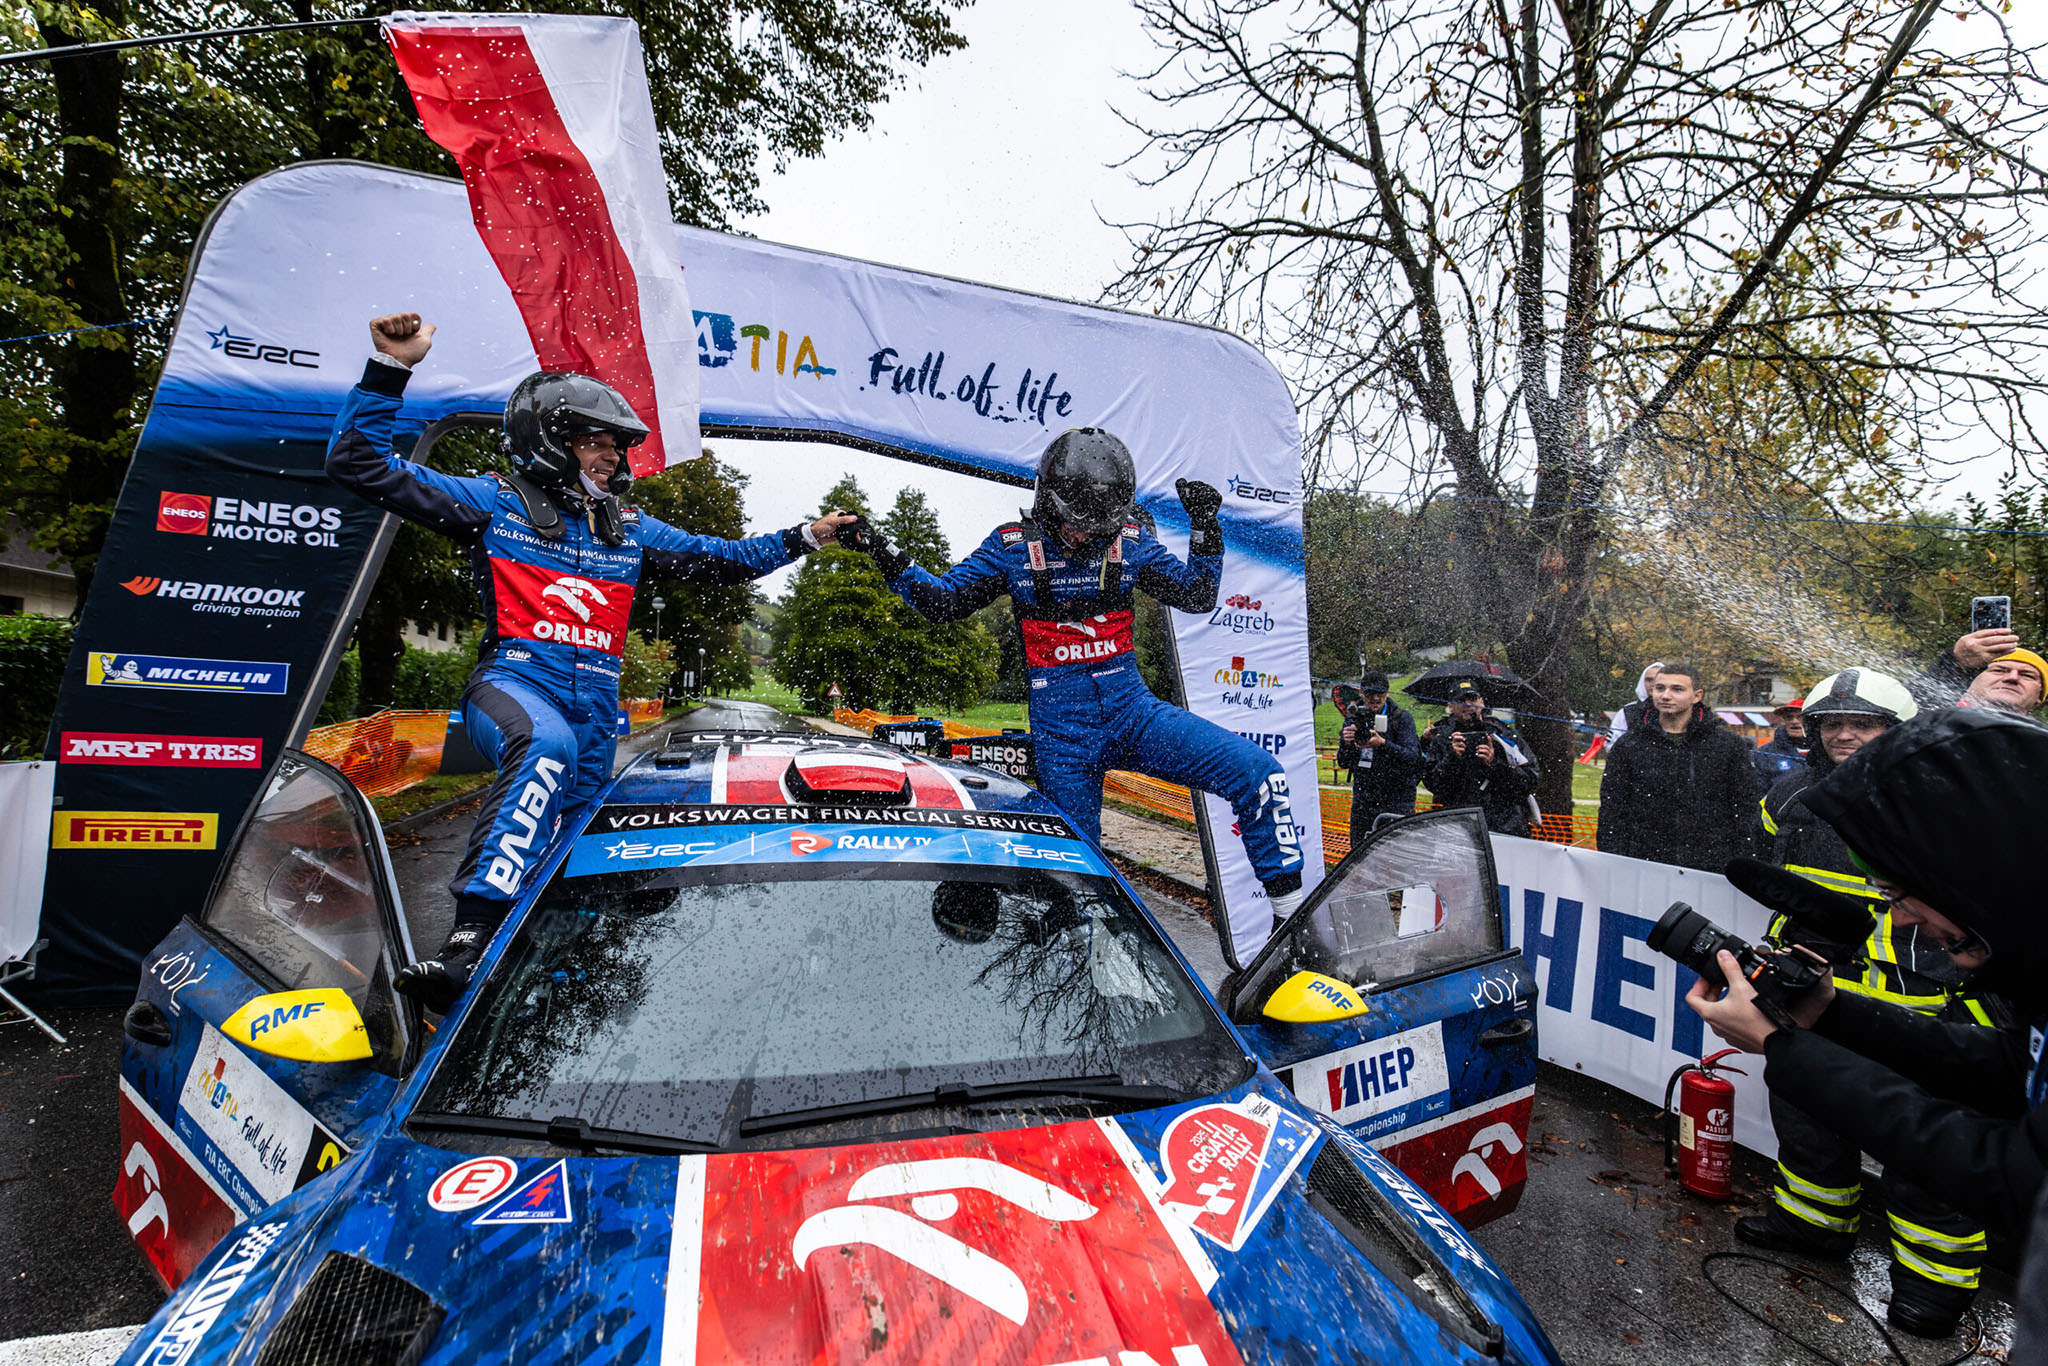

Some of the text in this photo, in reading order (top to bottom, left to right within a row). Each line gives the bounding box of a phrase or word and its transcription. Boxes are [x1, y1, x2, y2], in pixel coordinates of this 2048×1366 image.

[224, 340, 320, 369] ERC
[868, 347, 947, 401] Full
[1017, 368, 1073, 428] life
[1236, 484, 1291, 504] ERC
[162, 506, 206, 520] ENEOS
[214, 496, 342, 532] ENEOS
[213, 521, 340, 549] MOTOR OIL
[492, 526, 562, 551] VOLKSWAGEN
[192, 601, 301, 618] driving emotion
[1208, 606, 1275, 634] Zagreb
[532, 619, 612, 650] ORLEN
[507, 649, 532, 660] OMP
[1054, 639, 1118, 661] ORLEN
[146, 667, 272, 684] MICHELIN
[1213, 669, 1284, 688] CROATIA
[1222, 691, 1242, 705] Full
[1258, 693, 1274, 709] life
[66, 739, 257, 762] MRF TYRES
[971, 745, 1028, 764] ENEOS
[1010, 765, 1028, 776] OIL
[70, 818, 205, 843] PIRELLI
[608, 806, 1069, 838] VOLKSWAGEN FINANCIAL SERVICES
[449, 931, 478, 943] OMP
[1306, 979, 1354, 1012] RMF
[250, 1001, 326, 1042] RMF
[1358, 1046, 1415, 1102] HEP
[240, 1115, 264, 1149] Full
[270, 1142, 288, 1176] life
[1187, 1122, 1239, 1174] CROATIA
[1217, 1132, 1254, 1172] RALLY
[204, 1143, 217, 1164] FIA
[217, 1160, 232, 1185] ERC
[452, 1169, 496, 1195] E
